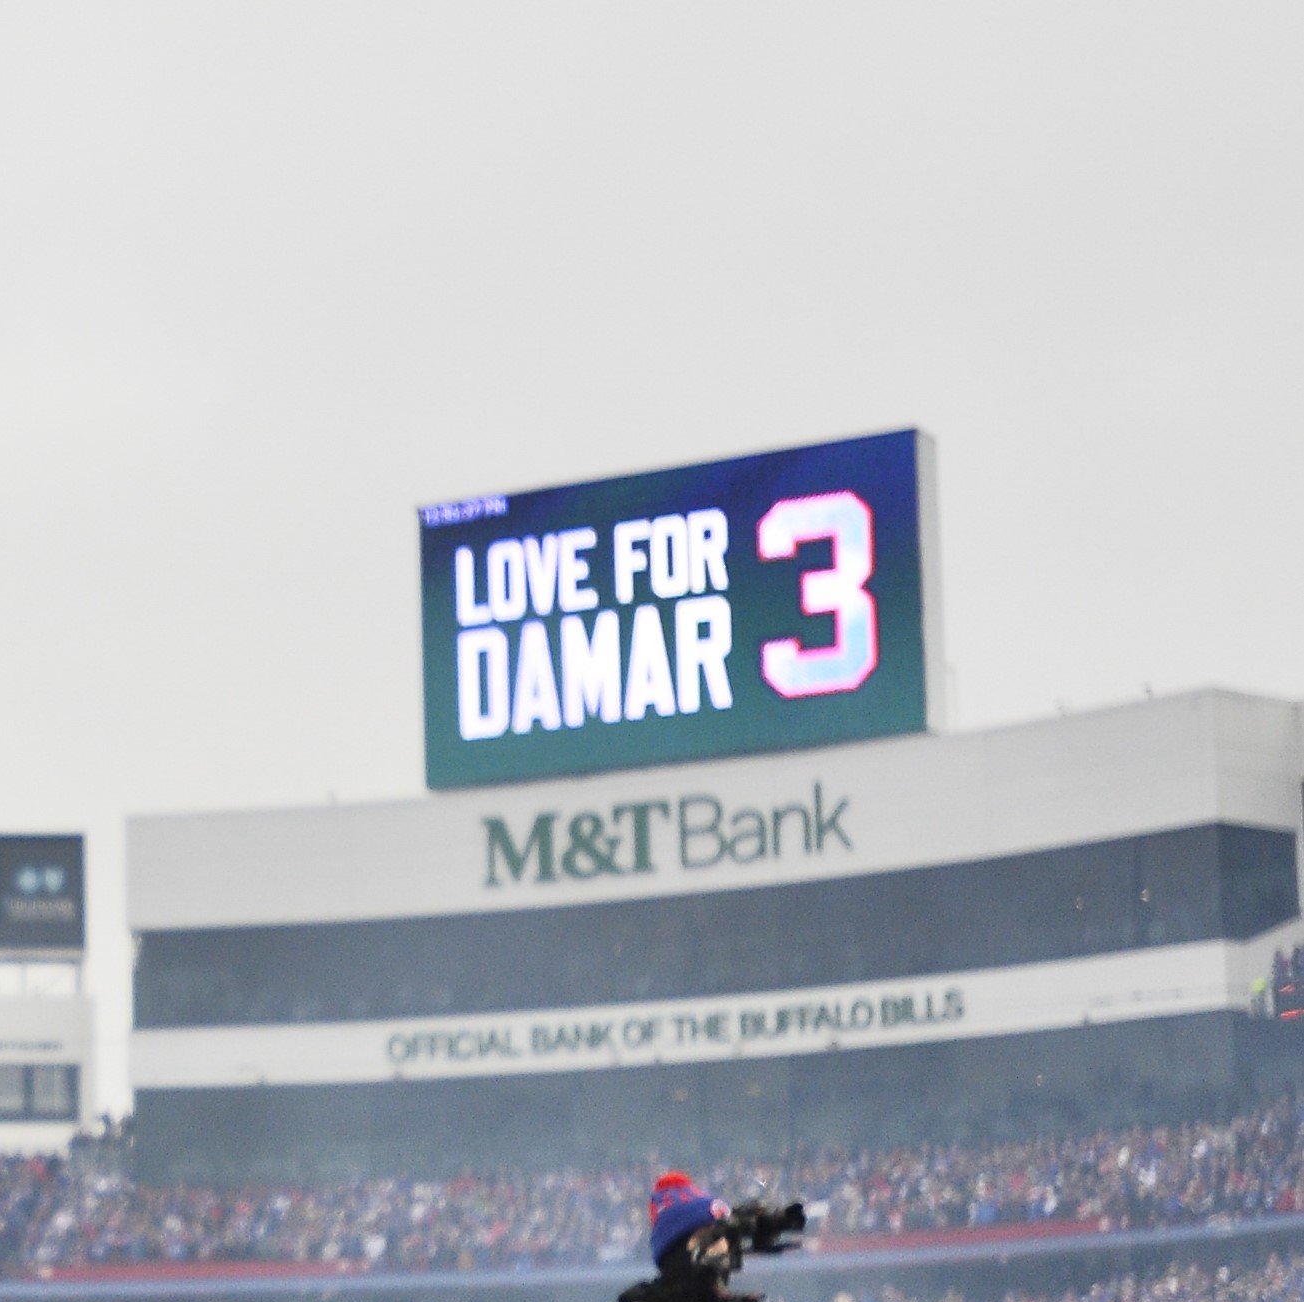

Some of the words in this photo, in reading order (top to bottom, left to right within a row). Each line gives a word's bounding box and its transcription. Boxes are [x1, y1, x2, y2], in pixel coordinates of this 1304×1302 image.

[454, 527, 599, 627] LOVE
[613, 507, 730, 604] FOR
[755, 489, 879, 700] 3
[456, 594, 734, 741] DAMAR
[481, 797, 672, 888] M&T
[677, 780, 854, 870] Bank
[387, 1027, 522, 1063] OFFICIAL
[529, 1019, 613, 1056] BANK
[621, 1014, 661, 1048] OF
[672, 1011, 731, 1043] THE
[739, 999, 874, 1041] BUFFALO
[880, 986, 965, 1028] BILLS
